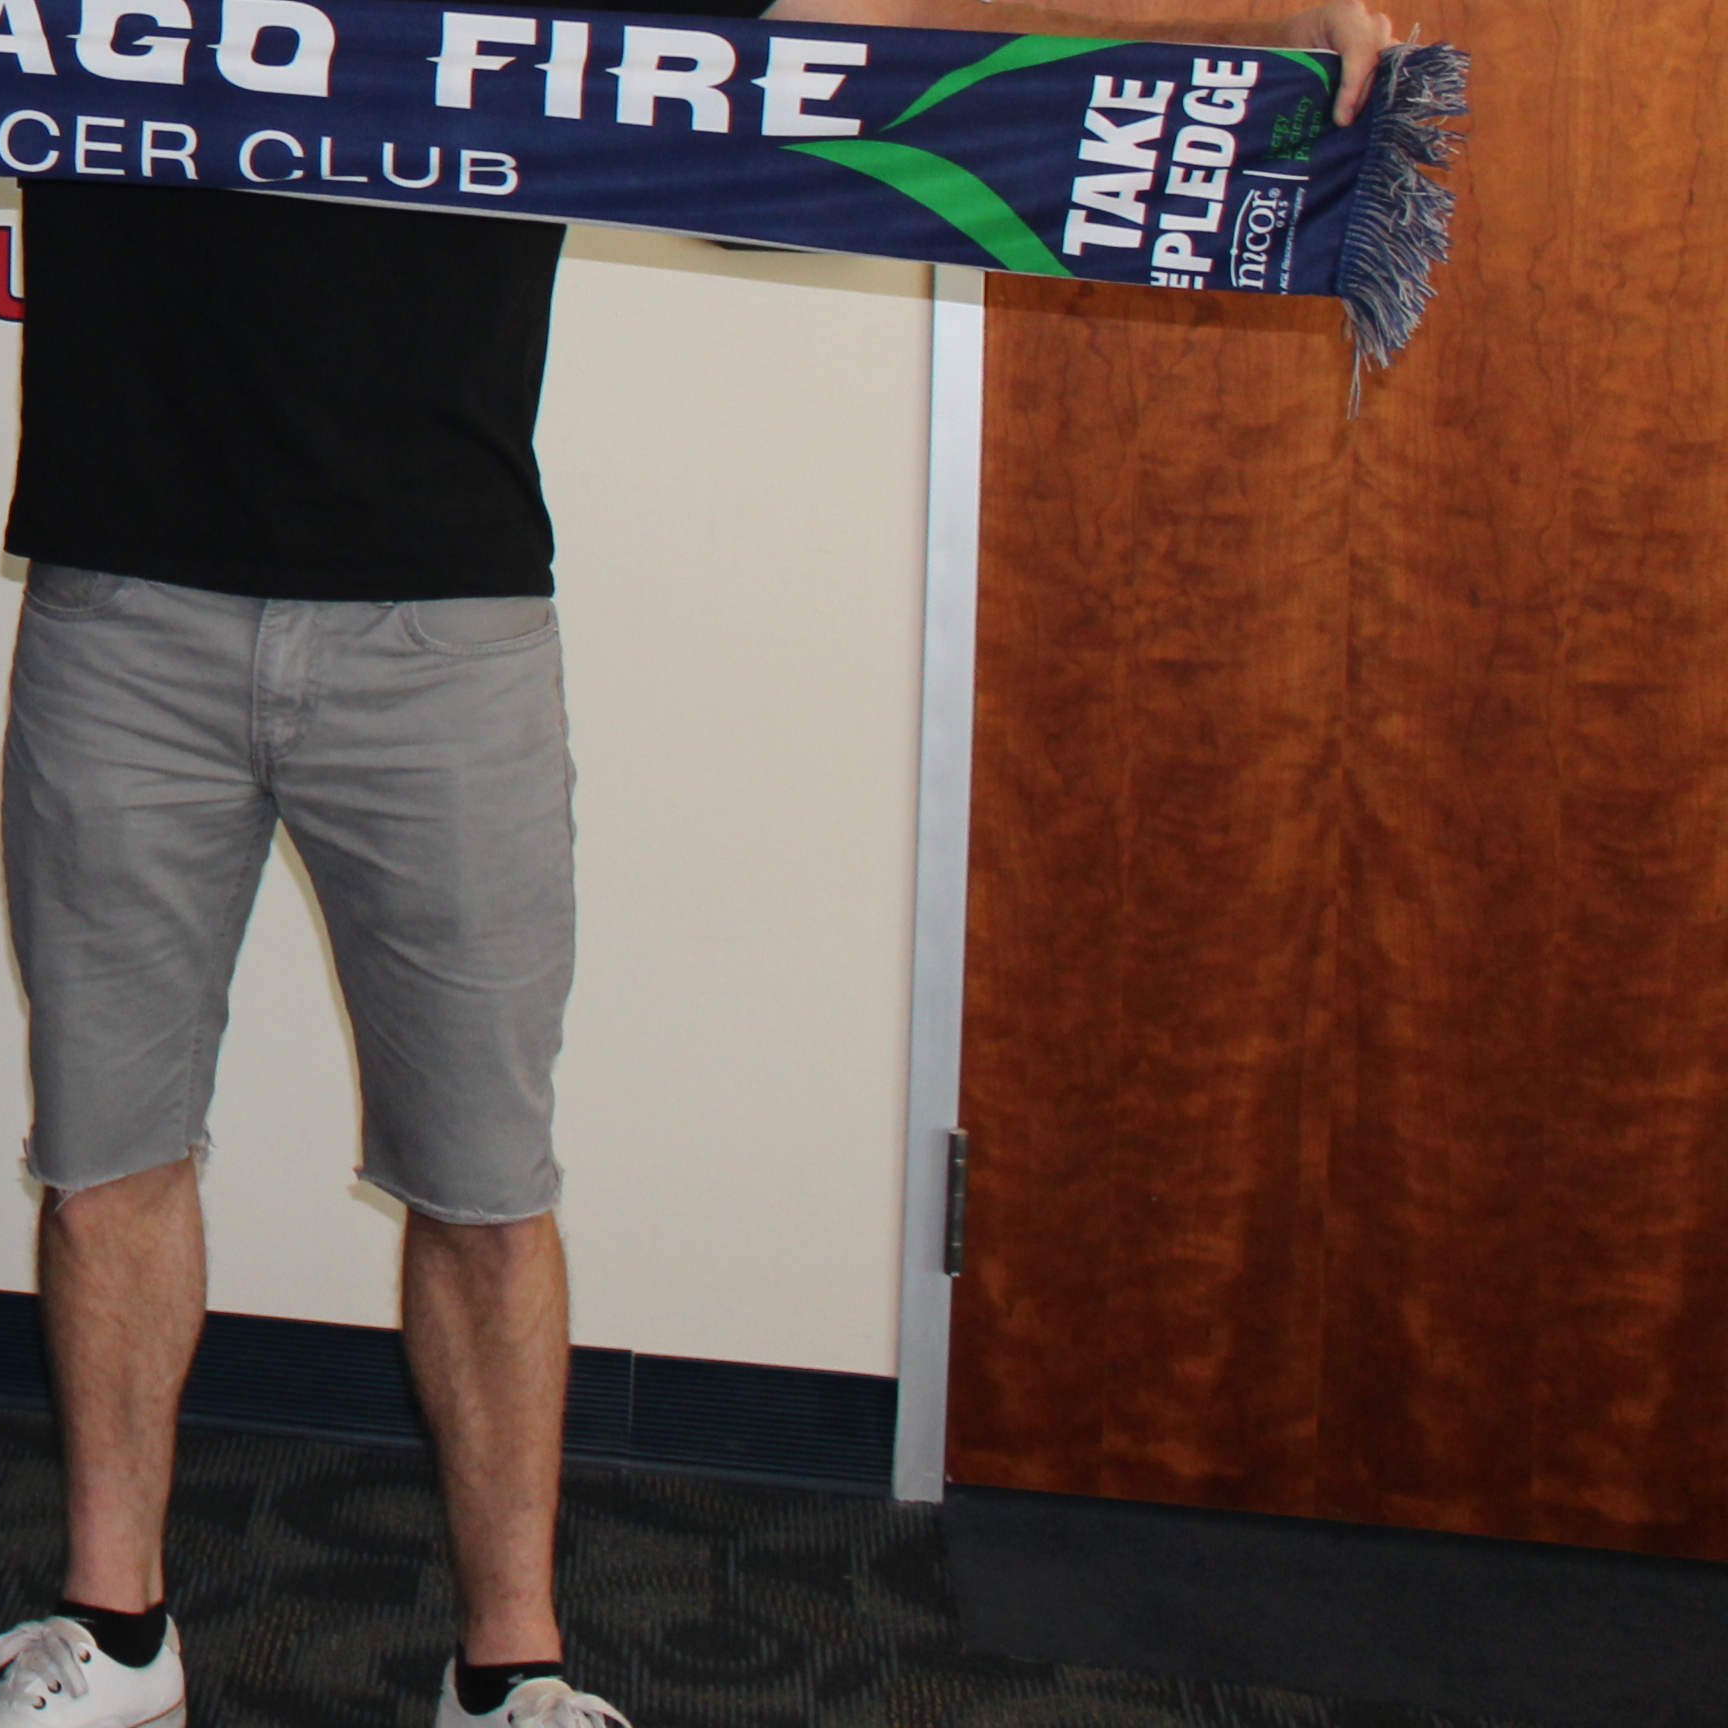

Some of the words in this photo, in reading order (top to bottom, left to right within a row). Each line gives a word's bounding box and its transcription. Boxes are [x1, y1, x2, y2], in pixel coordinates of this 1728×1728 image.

[426, 11, 868, 136] FIRE
[238, 130, 520, 196] CLUB
[1062, 75, 1176, 256] TAKE
[1151, 58, 1259, 272] PLEDGE
[1275, 200, 1289, 228] GAS
[1238, 189, 1277, 290] nicor
